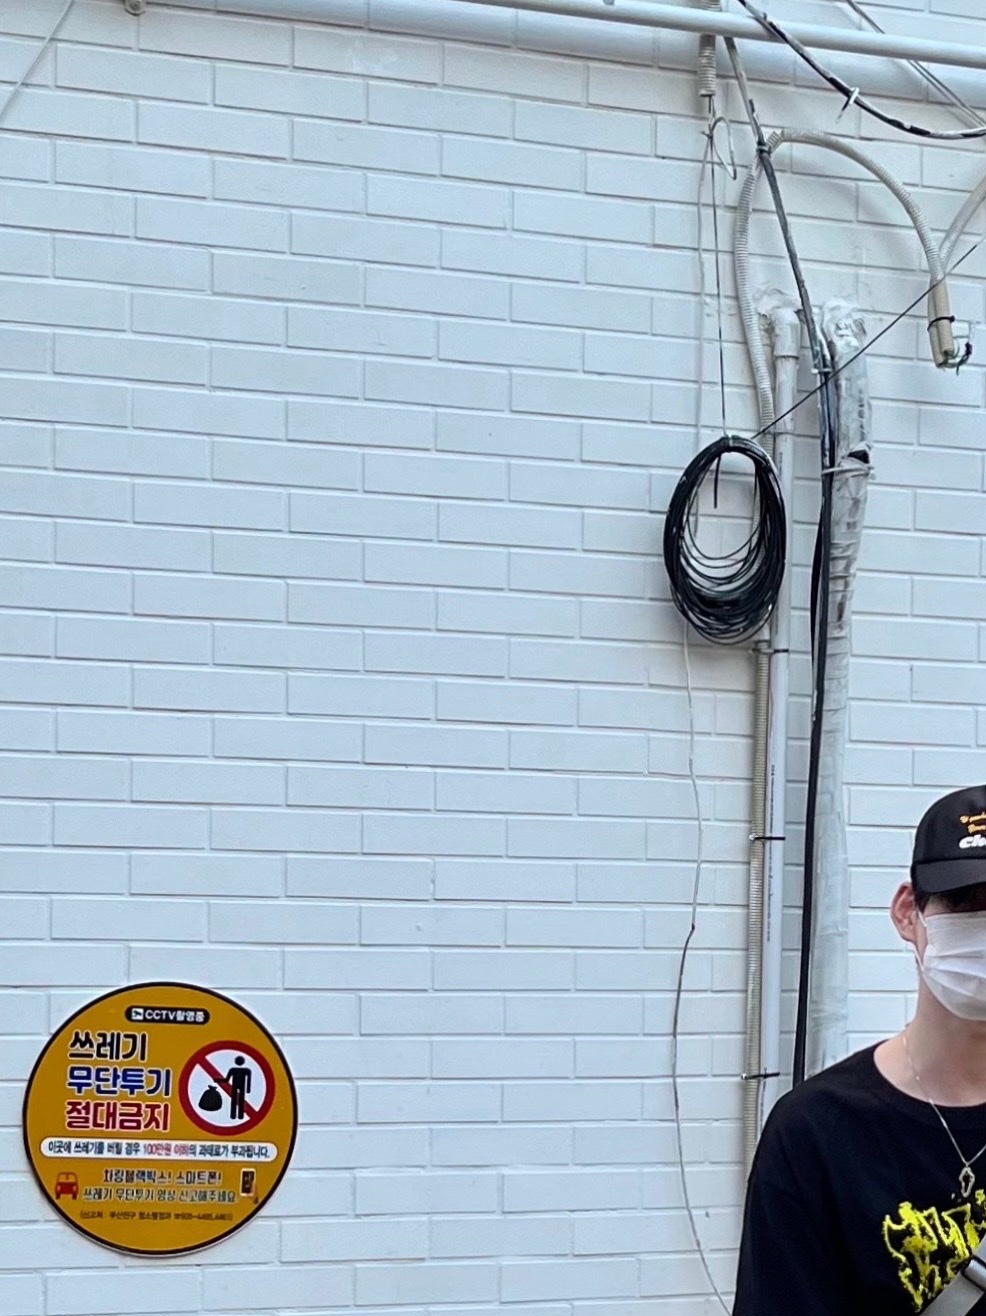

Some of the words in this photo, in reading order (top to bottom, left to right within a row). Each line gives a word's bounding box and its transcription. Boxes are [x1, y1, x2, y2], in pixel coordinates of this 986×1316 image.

[69, 1031, 147, 1061] 쓰레기
[67, 1066, 171, 1097] 무단투기
[66, 1101, 169, 1131] 절대금지
[48, 1140, 71, 1154] 이곳에
[125, 1142, 141, 1155] 경우
[84, 1187, 112, 1201] 쓰레기
[115, 1188, 154, 1201] 무단투기
